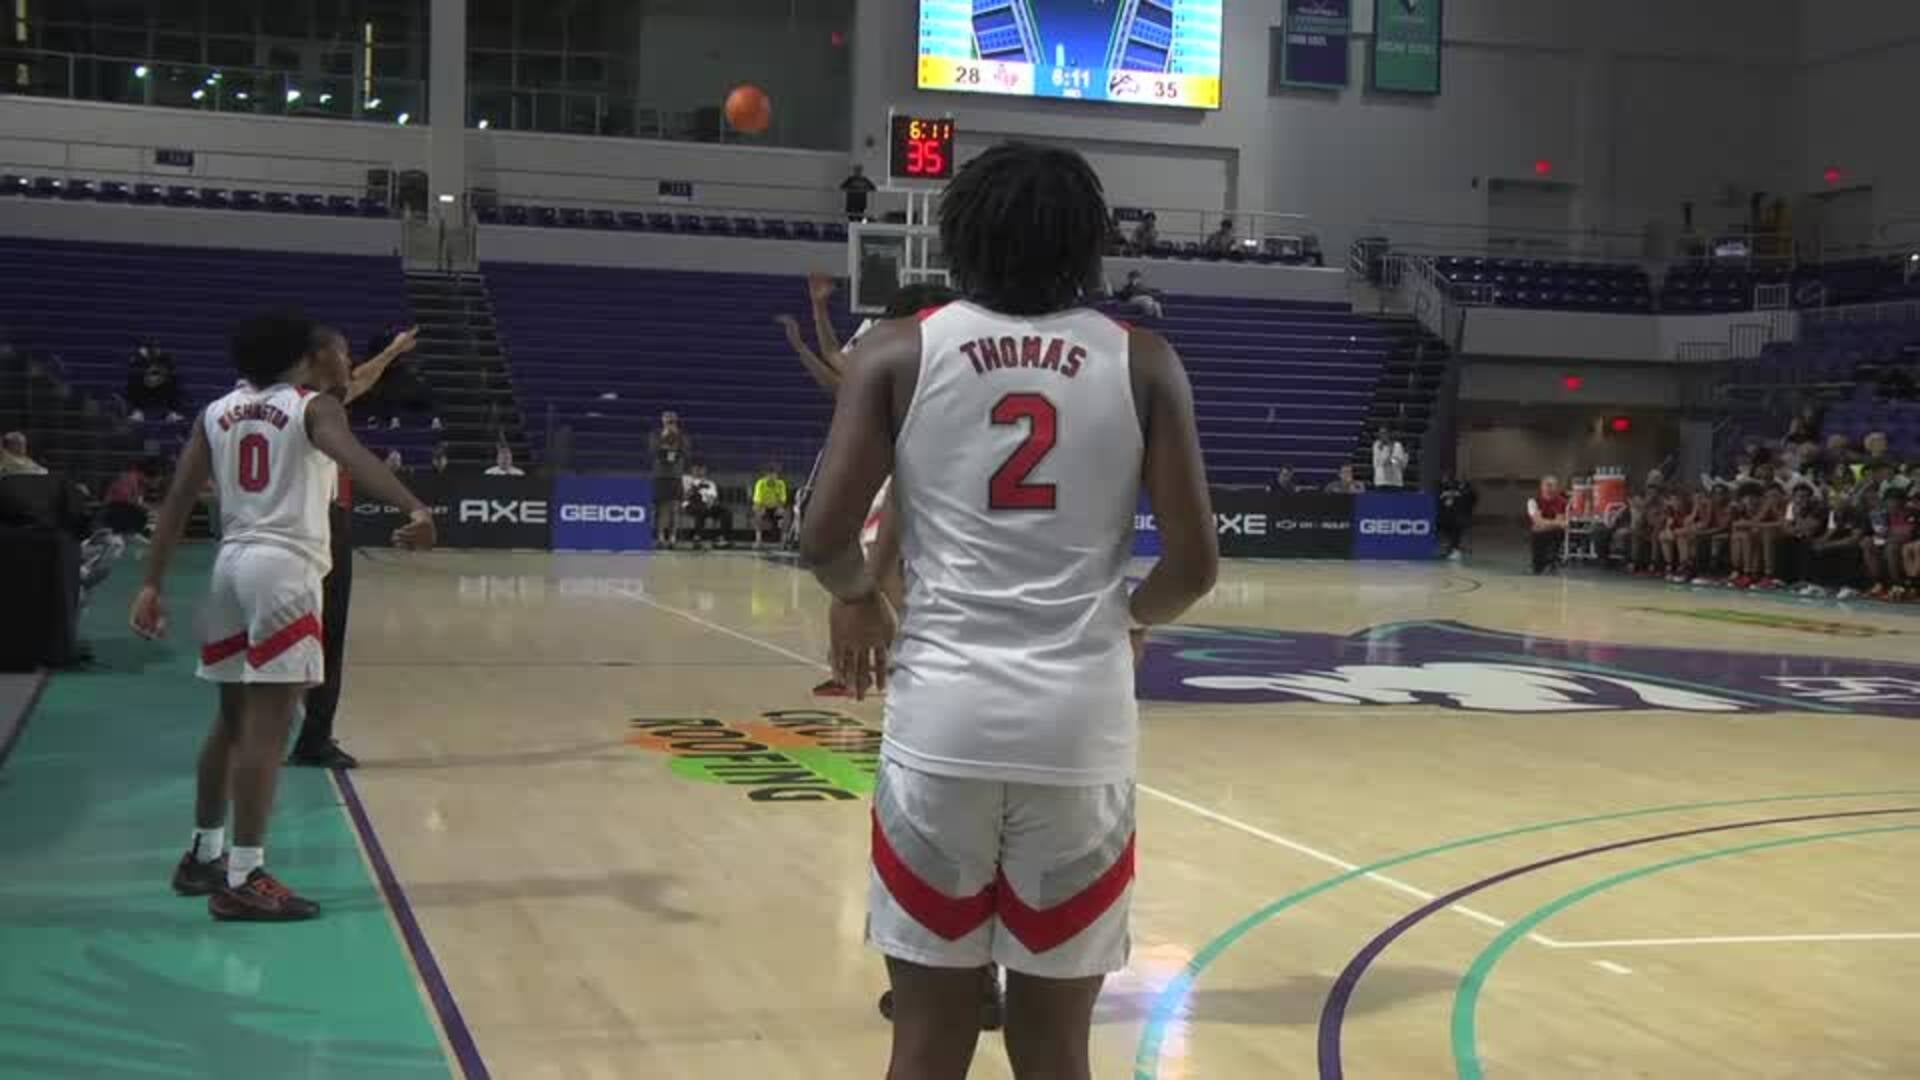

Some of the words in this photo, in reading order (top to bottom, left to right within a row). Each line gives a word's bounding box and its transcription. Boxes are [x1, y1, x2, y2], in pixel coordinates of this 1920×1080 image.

[955, 65, 980, 84] 28
[1051, 68, 1091, 88] 6:11
[1155, 81, 1177, 98] 35
[910, 121, 950, 140] 6:11
[907, 139, 942, 172] 35
[959, 335, 1087, 379] THOMAS
[988, 391, 1058, 511] 2
[239, 432, 271, 494] 0
[459, 499, 548, 524] AXE
[560, 503, 646, 523] GEICO
[1211, 513, 1267, 535] XE
[1359, 518, 1431, 536] GEICO
[629, 717, 862, 802] ROOFING
